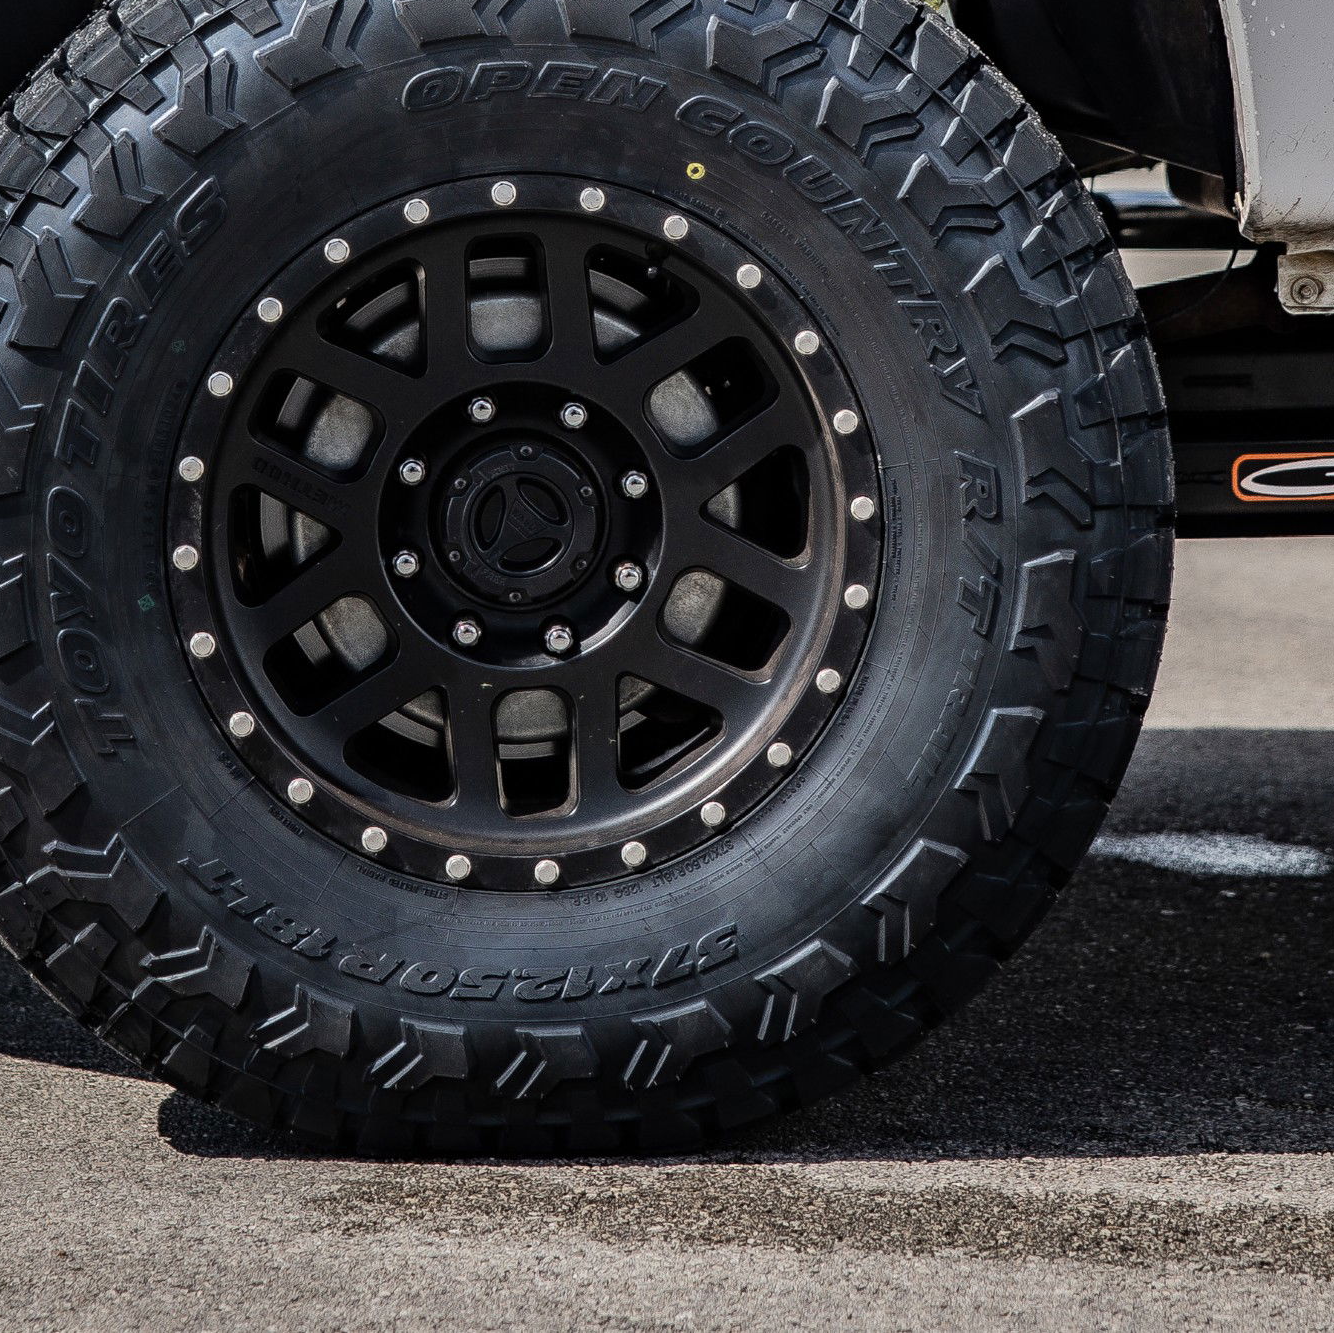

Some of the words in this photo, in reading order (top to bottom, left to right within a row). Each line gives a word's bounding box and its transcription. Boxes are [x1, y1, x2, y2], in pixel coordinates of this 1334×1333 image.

[53, 173, 228, 466] TIRES
[402, 60, 668, 112] OPEN
[675, 94, 987, 416] COUNTRY
[952, 451, 1005, 637] R/T
[45, 484, 137, 756] TOYO
[177, 856, 742, 1003] 37X1250R18LT
